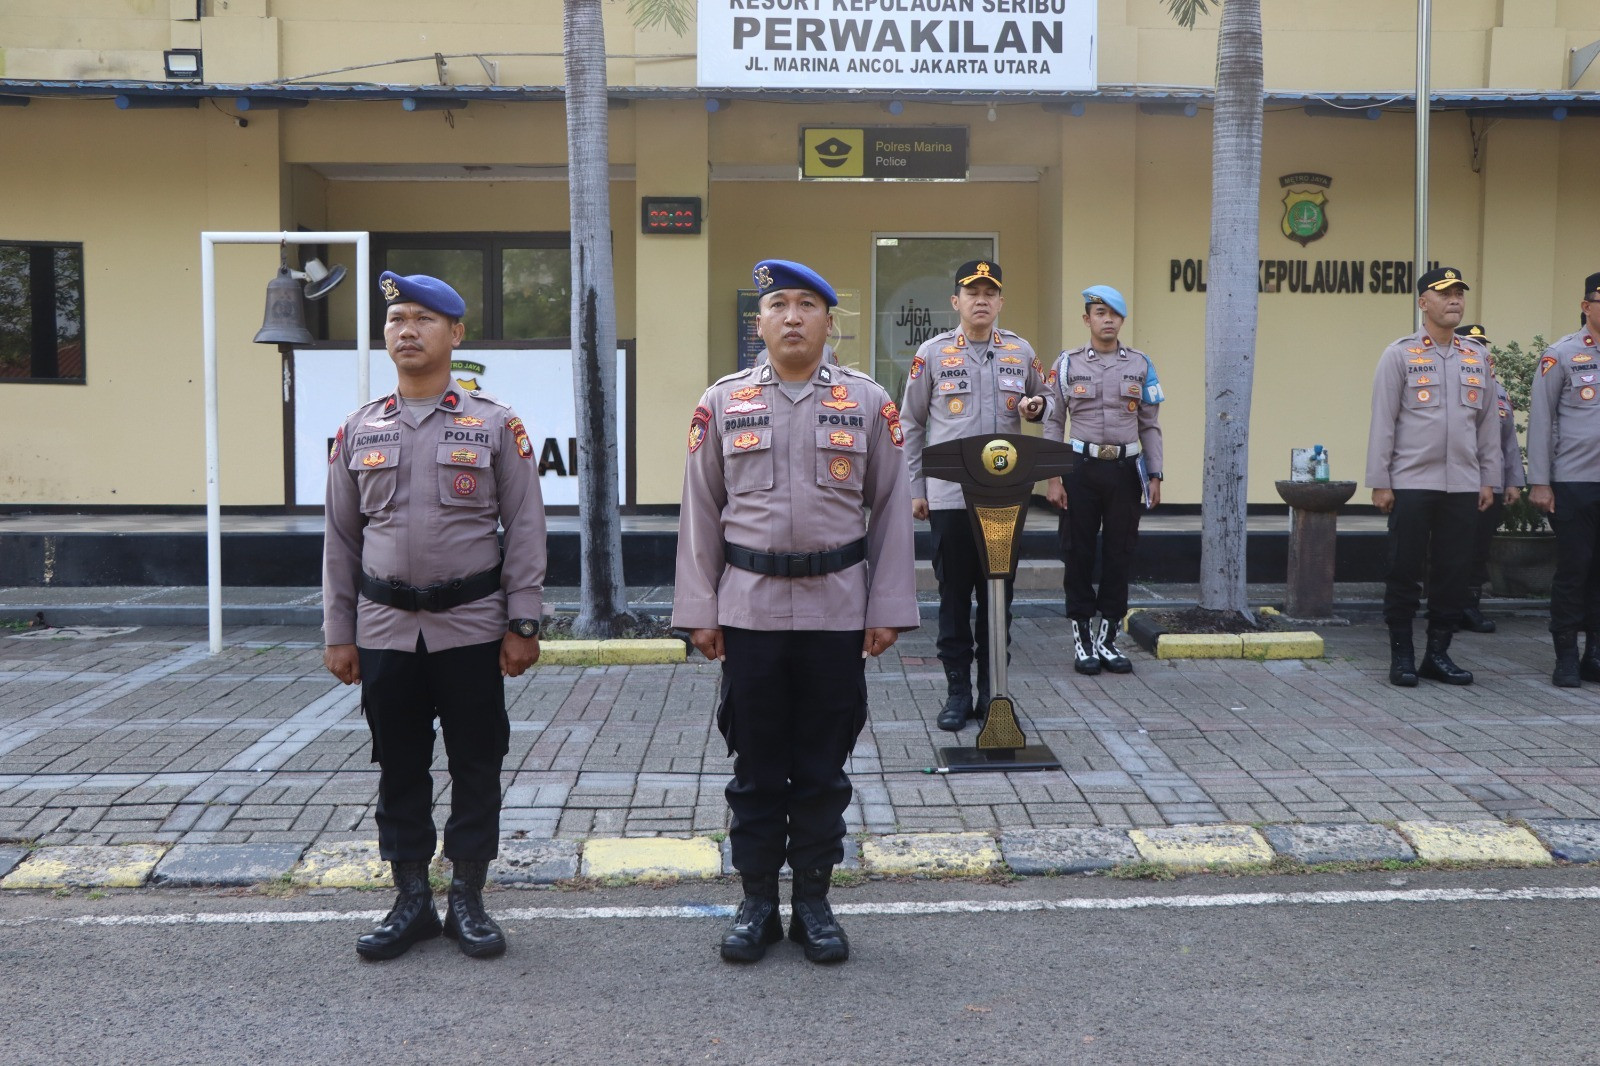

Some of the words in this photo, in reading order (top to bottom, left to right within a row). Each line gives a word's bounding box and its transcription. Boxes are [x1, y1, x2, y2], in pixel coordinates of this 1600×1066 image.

[729, 0, 820, 10] RESORT
[832, 0, 973, 12] KEPULAUAN
[982, 0, 1066, 14] SERIBU
[733, 16, 1063, 54] PERWAKILAN
[745, 57, 768, 71] JL.
[774, 57, 840, 73] MARINA
[847, 58, 904, 74] ANCOL
[910, 59, 989, 74] JAKARTA
[994, 60, 1051, 74] UTARA
[875, 141, 911, 152] Polres
[914, 141, 953, 153] Marina
[875, 156, 907, 167] Police
[1284, 175, 1310, 184] METRO
[1311, 176, 1328, 185] JAYA
[1369, 260, 1439, 293] SERI
[896, 305, 932, 327] JAGA
[464, 362, 481, 372] JAYA
[999, 367, 1024, 377] POLRI
[1408, 365, 1437, 374] ZAROKI
[1460, 365, 1483, 374] POLRI
[940, 369, 968, 378] ARGA
[818, 414, 864, 427] POLRI
[356, 432, 400, 447] ACHMAD.G
[444, 431, 489, 443] POLRI
